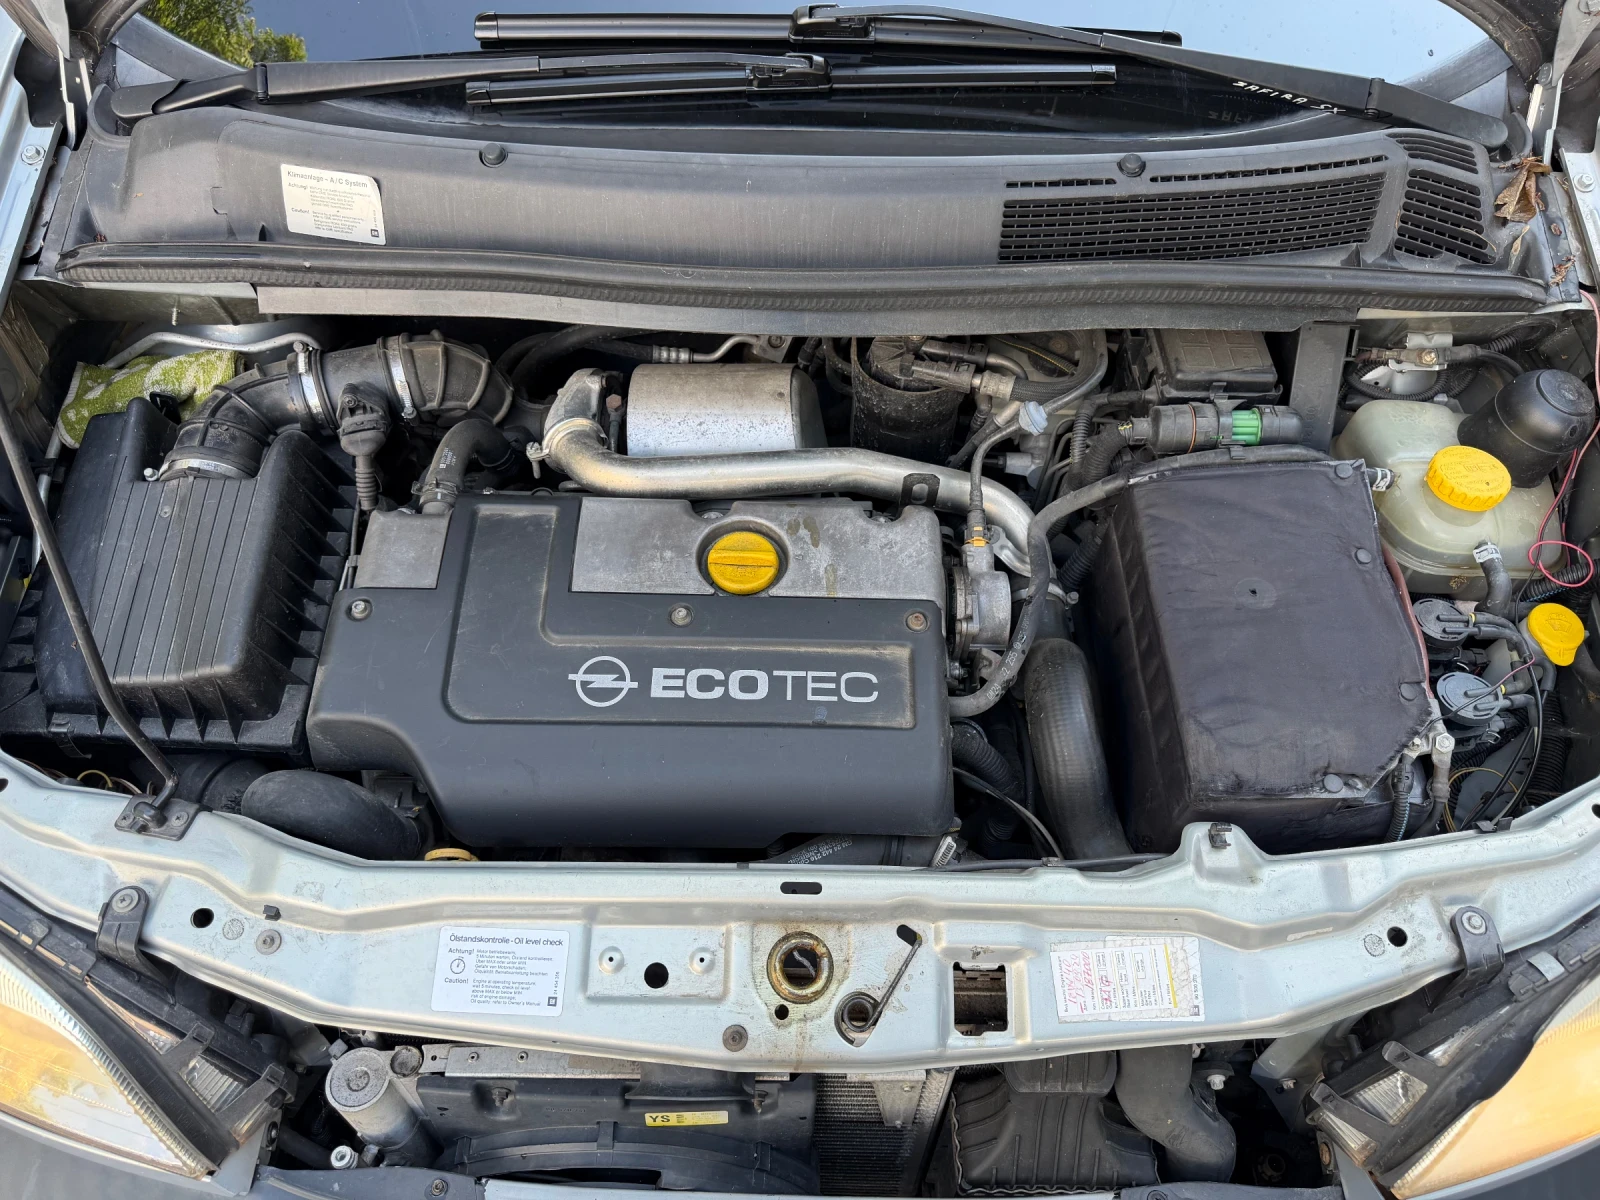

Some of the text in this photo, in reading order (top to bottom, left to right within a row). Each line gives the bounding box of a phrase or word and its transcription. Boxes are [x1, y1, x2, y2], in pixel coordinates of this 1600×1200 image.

[288, 171, 323, 182] Klimaanlage
[345, 179, 367, 188] System
[651, 667, 878, 702] ECOTEC
